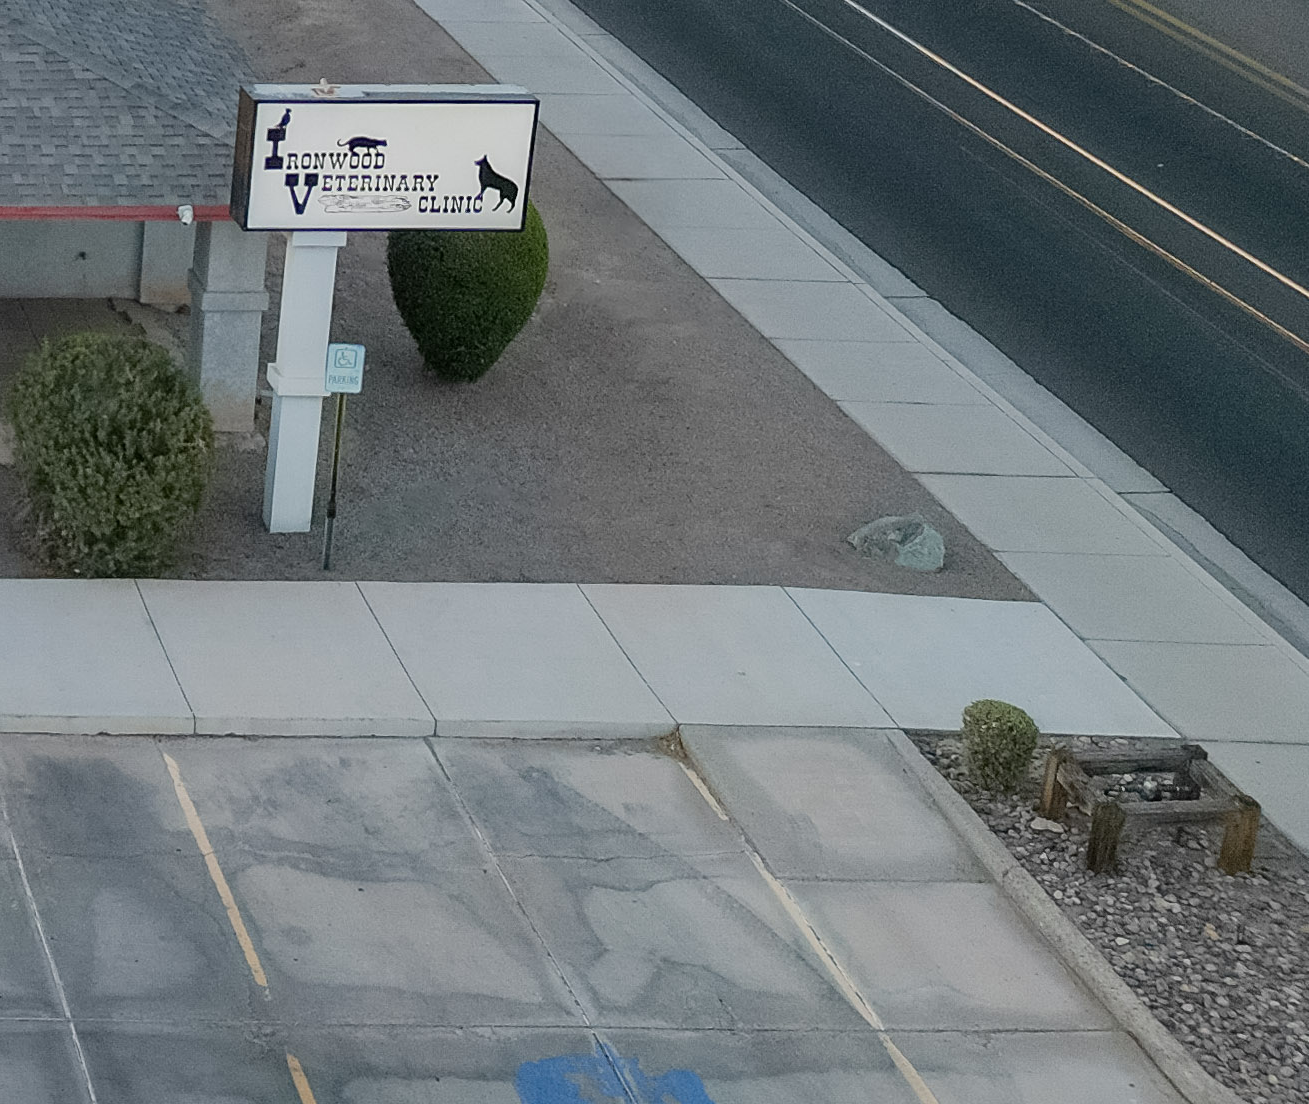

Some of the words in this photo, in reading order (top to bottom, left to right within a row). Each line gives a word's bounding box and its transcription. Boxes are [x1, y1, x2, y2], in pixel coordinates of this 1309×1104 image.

[264, 127, 386, 170] IRONWOOD
[284, 173, 440, 215] VETERINARY
[417, 195, 483, 214] CLINIC
[328, 375, 359, 386] PARKING
